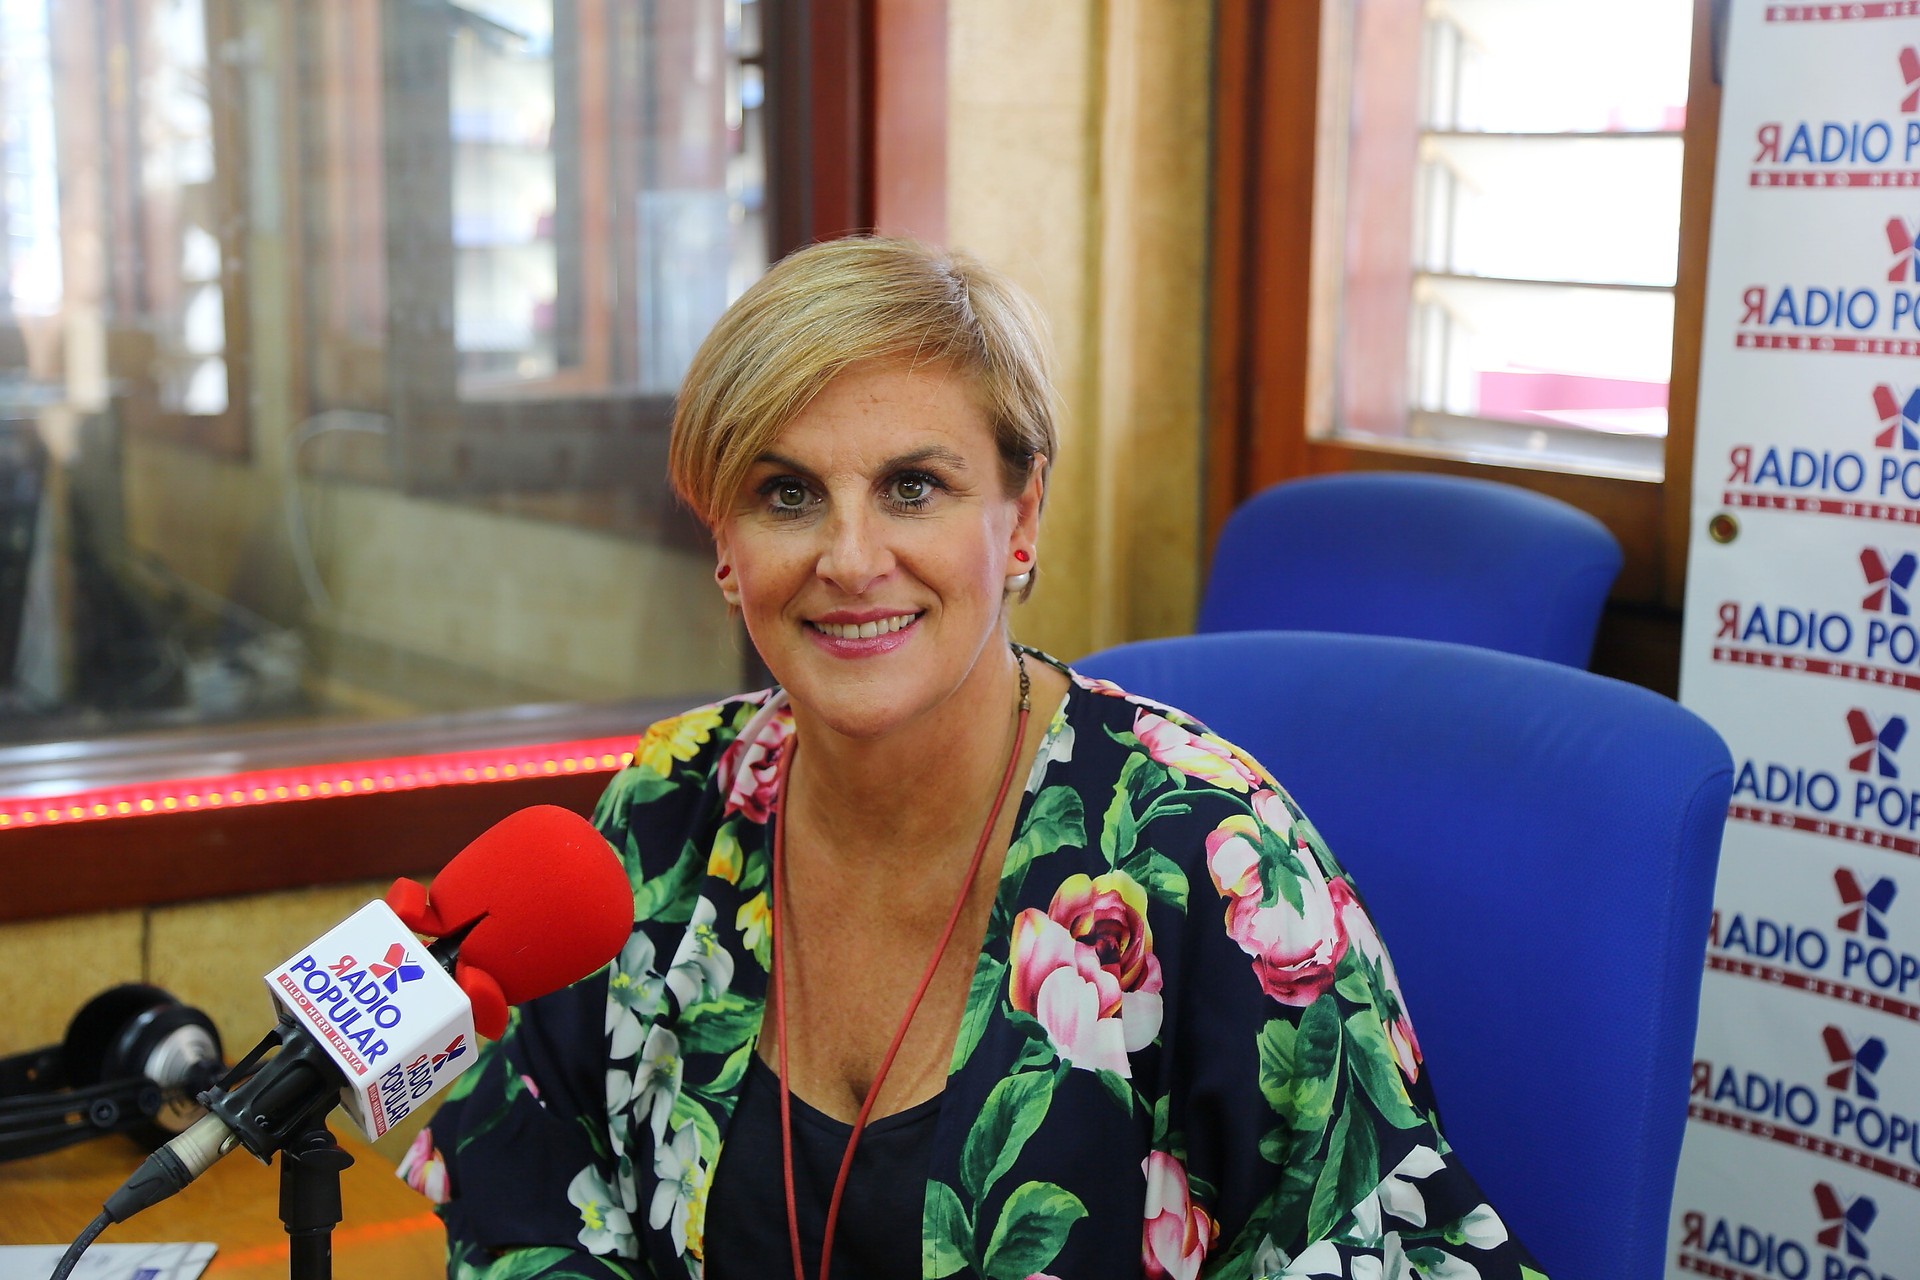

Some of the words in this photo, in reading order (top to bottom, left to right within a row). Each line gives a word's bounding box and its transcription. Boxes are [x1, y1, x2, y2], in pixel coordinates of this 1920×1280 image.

[1892, 292, 1920, 331] P
[1733, 760, 1839, 812] ADIO
[282, 978, 308, 1006] BILBO
[306, 1007, 333, 1035] HERRI
[330, 1035, 362, 1072] IRRATIA
[289, 955, 389, 1065] POPULAR
[328, 955, 402, 1029] RADIO
[380, 1063, 410, 1127] POPULAR
